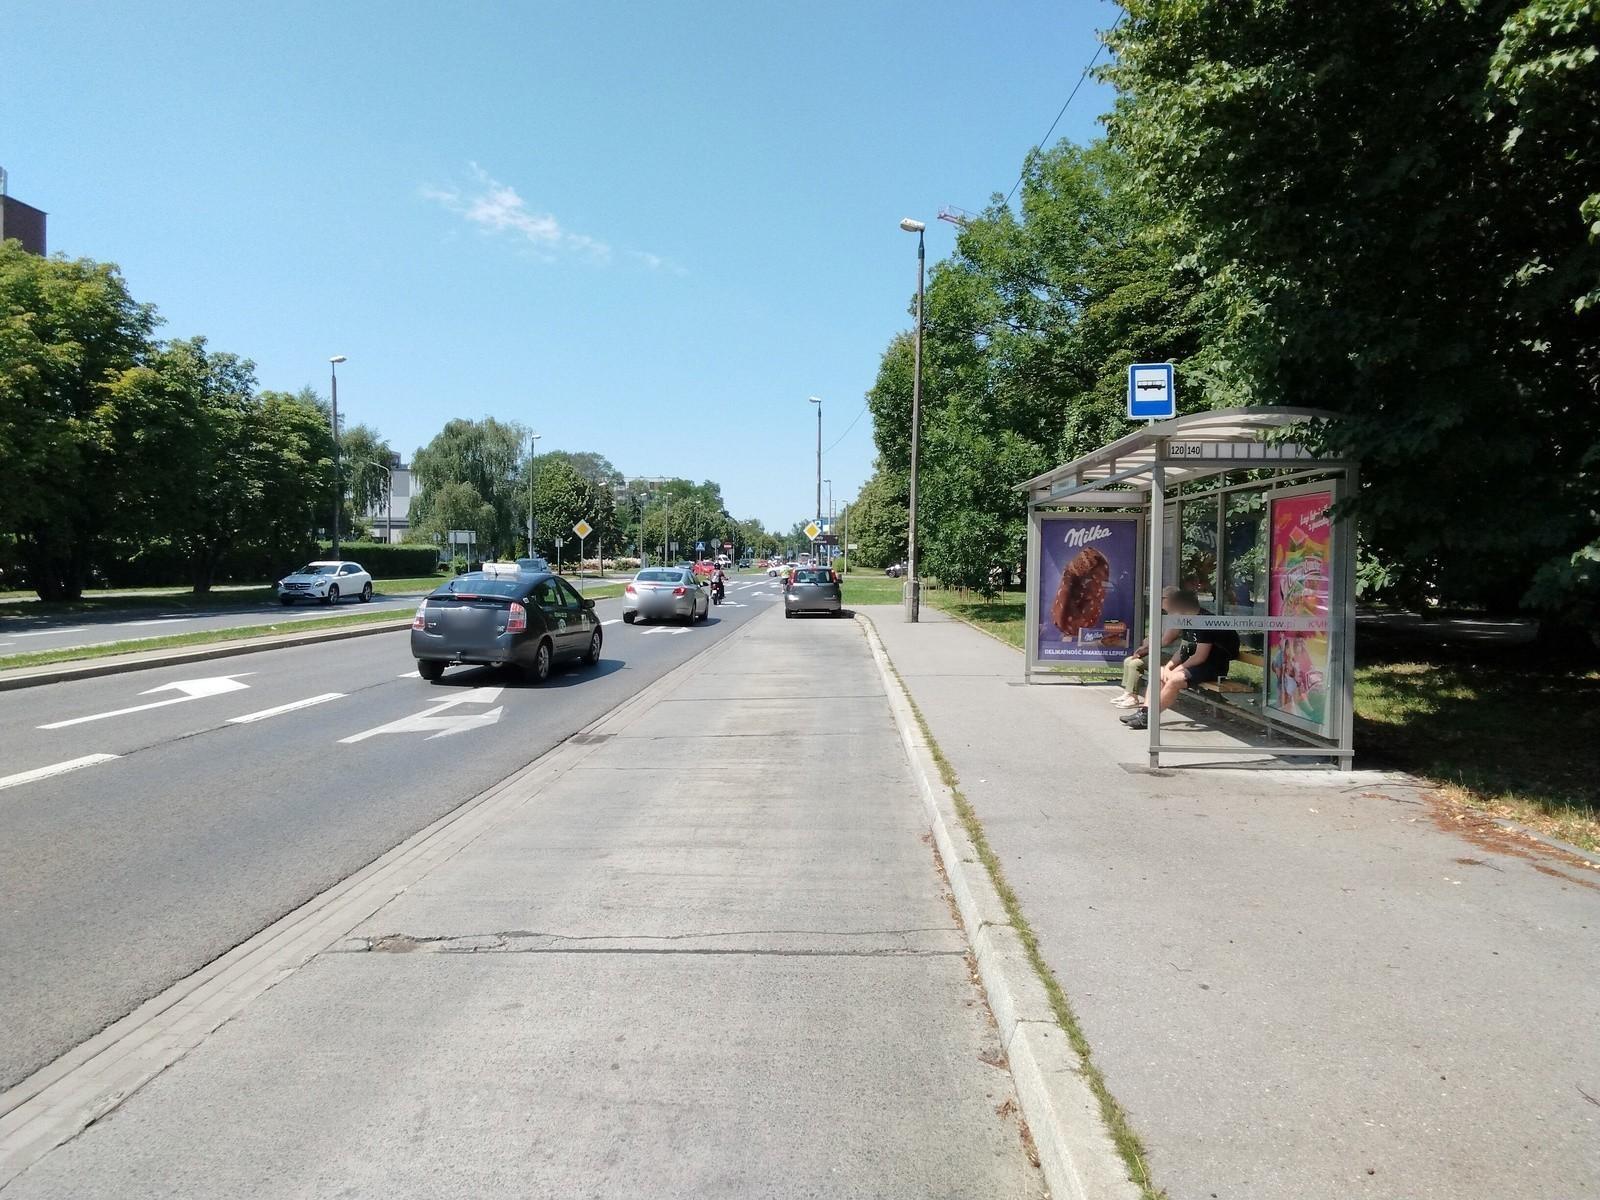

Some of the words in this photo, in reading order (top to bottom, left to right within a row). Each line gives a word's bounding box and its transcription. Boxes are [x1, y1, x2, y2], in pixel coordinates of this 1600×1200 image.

[1171, 446, 1184, 454] 120
[1187, 446, 1200, 454] 140
[1064, 525, 1112, 547] Milka
[1044, 648, 1082, 656] DELIKATNOŚĆ
